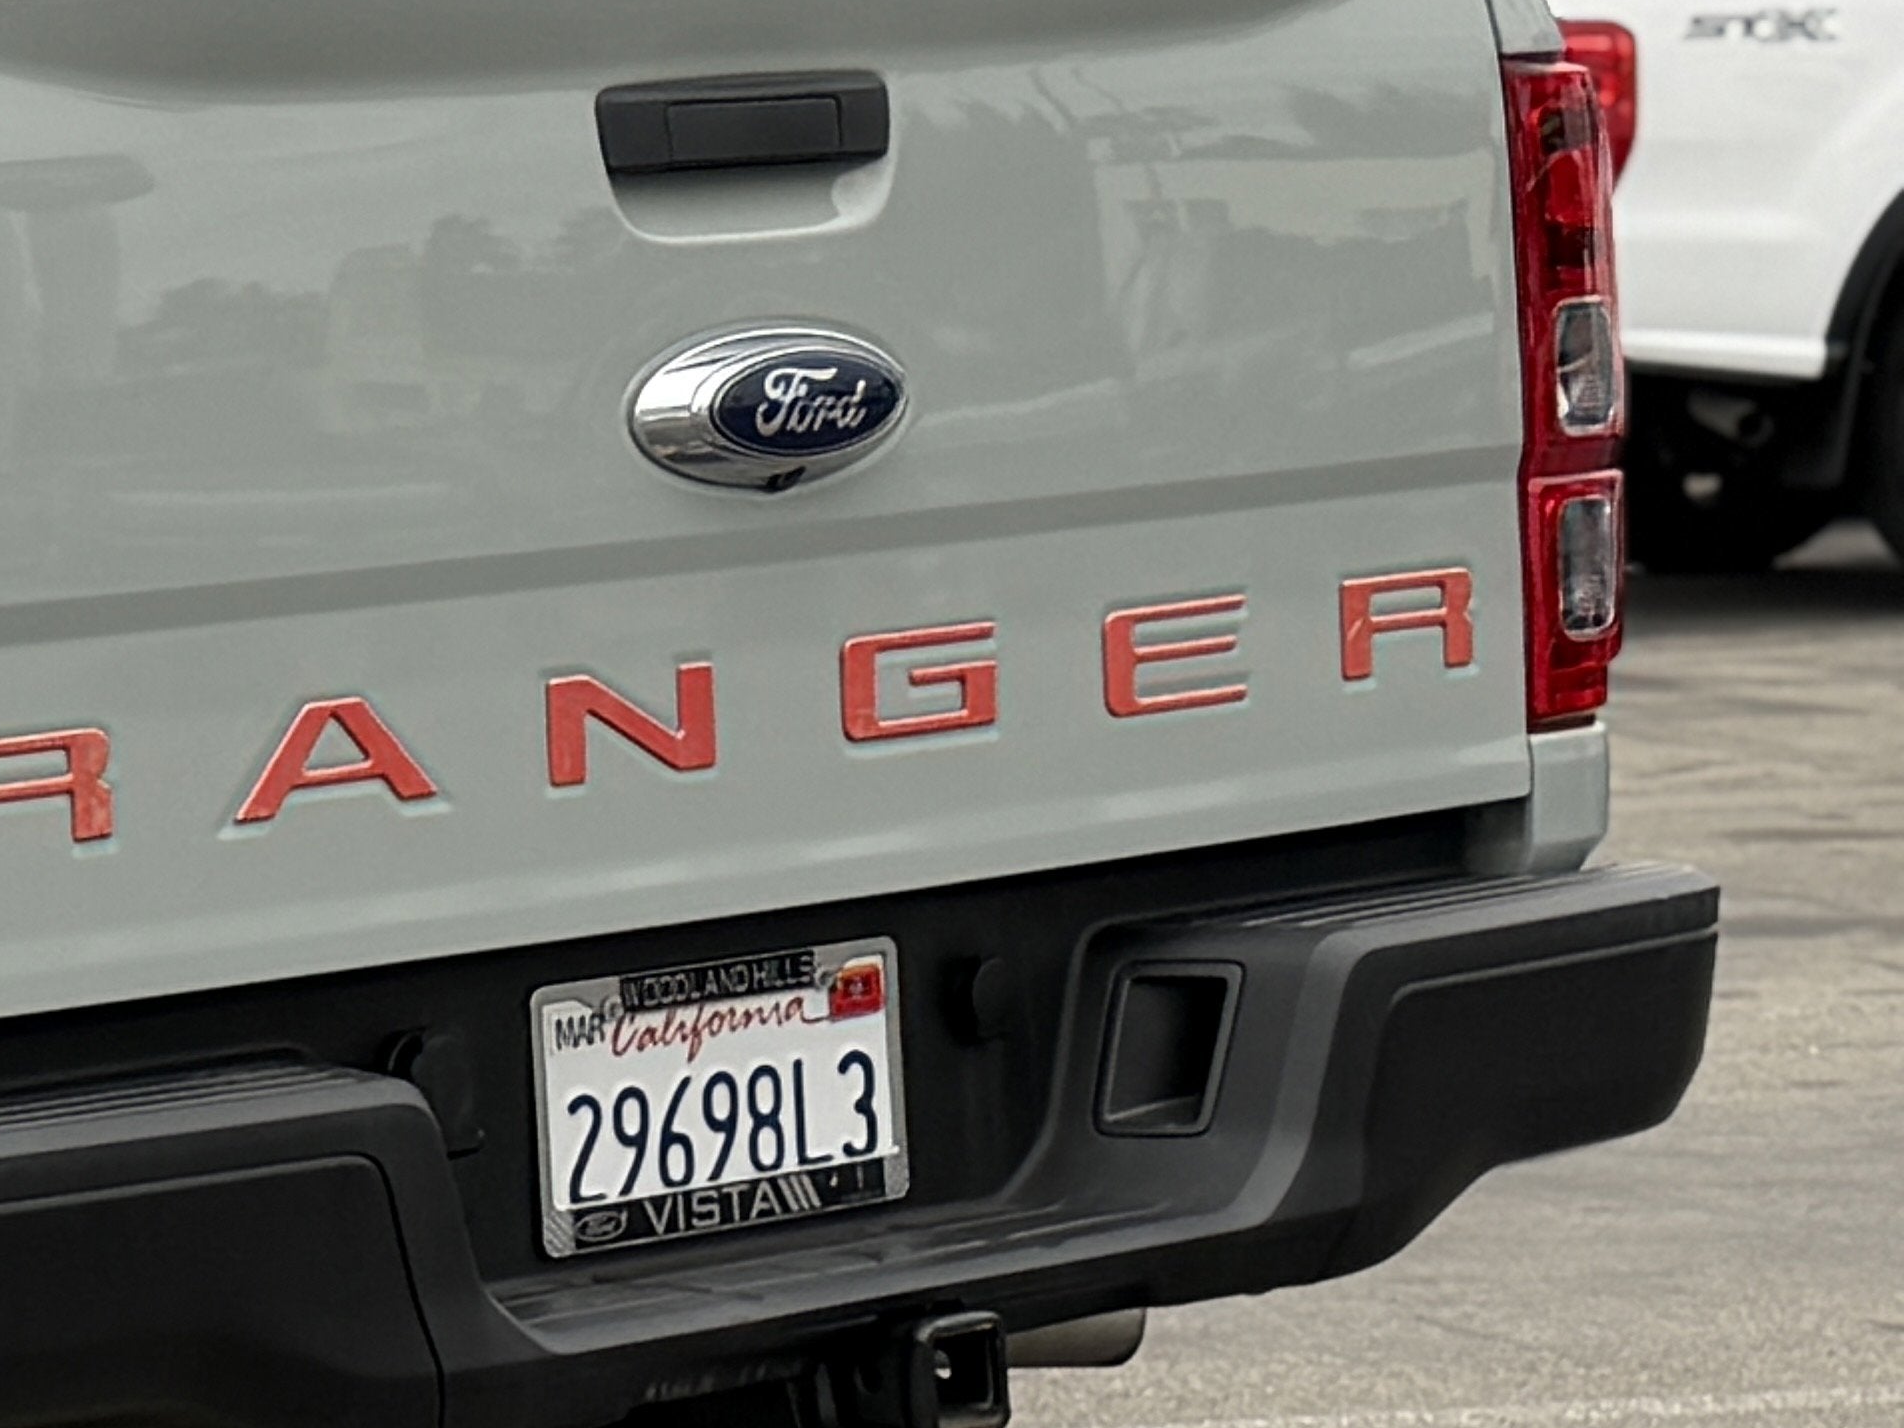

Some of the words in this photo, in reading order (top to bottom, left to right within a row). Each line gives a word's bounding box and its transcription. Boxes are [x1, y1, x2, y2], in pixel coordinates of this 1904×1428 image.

[755, 367, 868, 438] Ford
[624, 963, 749, 1008] WOODLAND
[752, 954, 813, 990] HILLS
[554, 1011, 606, 1052] MAR
[611, 994, 831, 1063] California
[565, 1048, 880, 1204] 29698L3
[643, 1184, 782, 1236] VISTA
